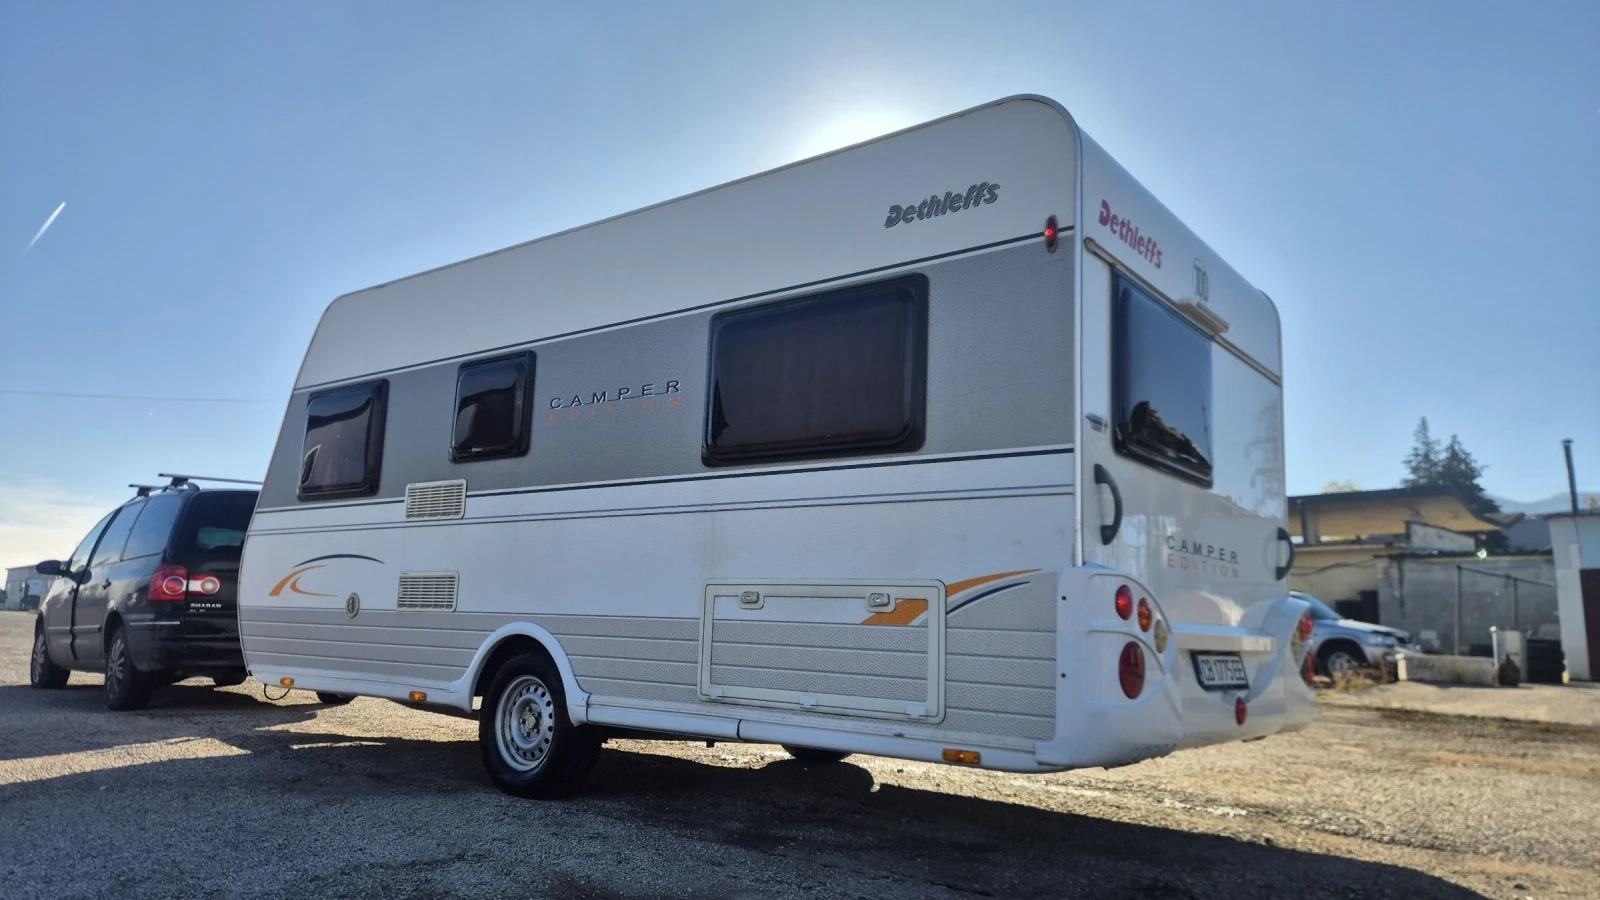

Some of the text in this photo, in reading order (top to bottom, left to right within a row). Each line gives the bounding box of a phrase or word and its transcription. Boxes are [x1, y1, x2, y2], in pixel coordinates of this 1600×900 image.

[884, 181, 1000, 228] Dethleffs
[1098, 199, 1163, 269] Dethleffs
[550, 380, 681, 409] CAMPER
[1166, 535, 1239, 564] CAMPER
[1166, 553, 1240, 579] EDITION
